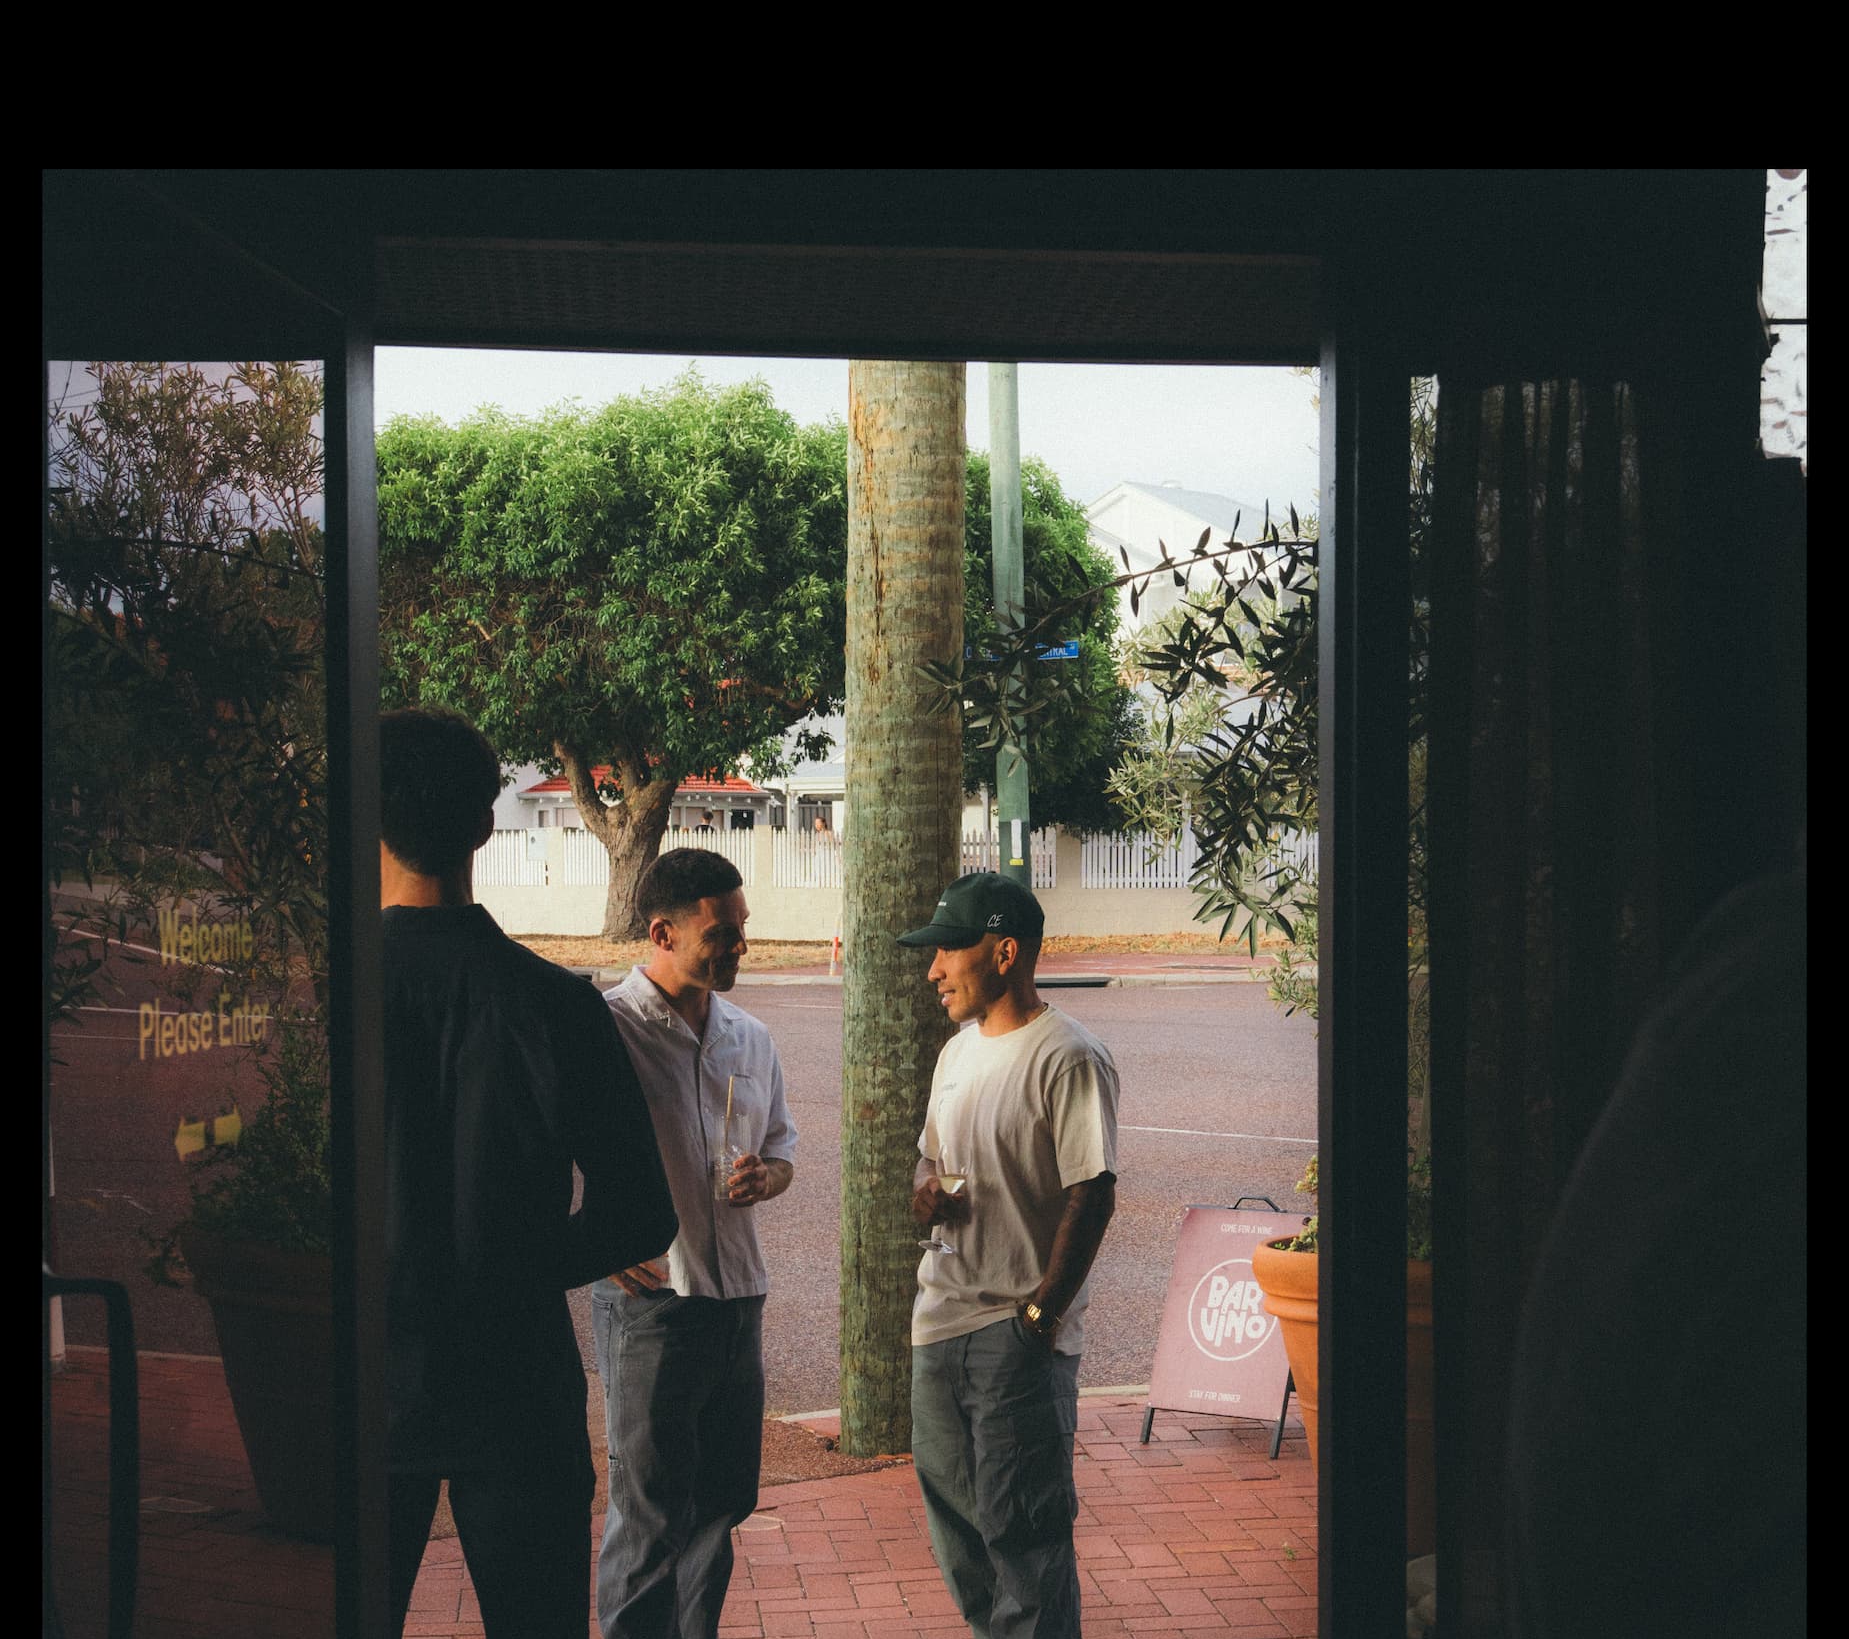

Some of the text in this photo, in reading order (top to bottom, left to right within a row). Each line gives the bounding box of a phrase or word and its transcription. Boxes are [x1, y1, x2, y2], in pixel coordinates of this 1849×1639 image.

[159, 906, 253, 968] Welcome
[140, 991, 270, 1059] Please Enter
[1220, 1223, 1237, 1234] COME
[1238, 1224, 1250, 1234] FOR
[1208, 1276, 1263, 1314] BAR
[1201, 1307, 1267, 1347] VINO
[1204, 1391, 1217, 1401] FOR
